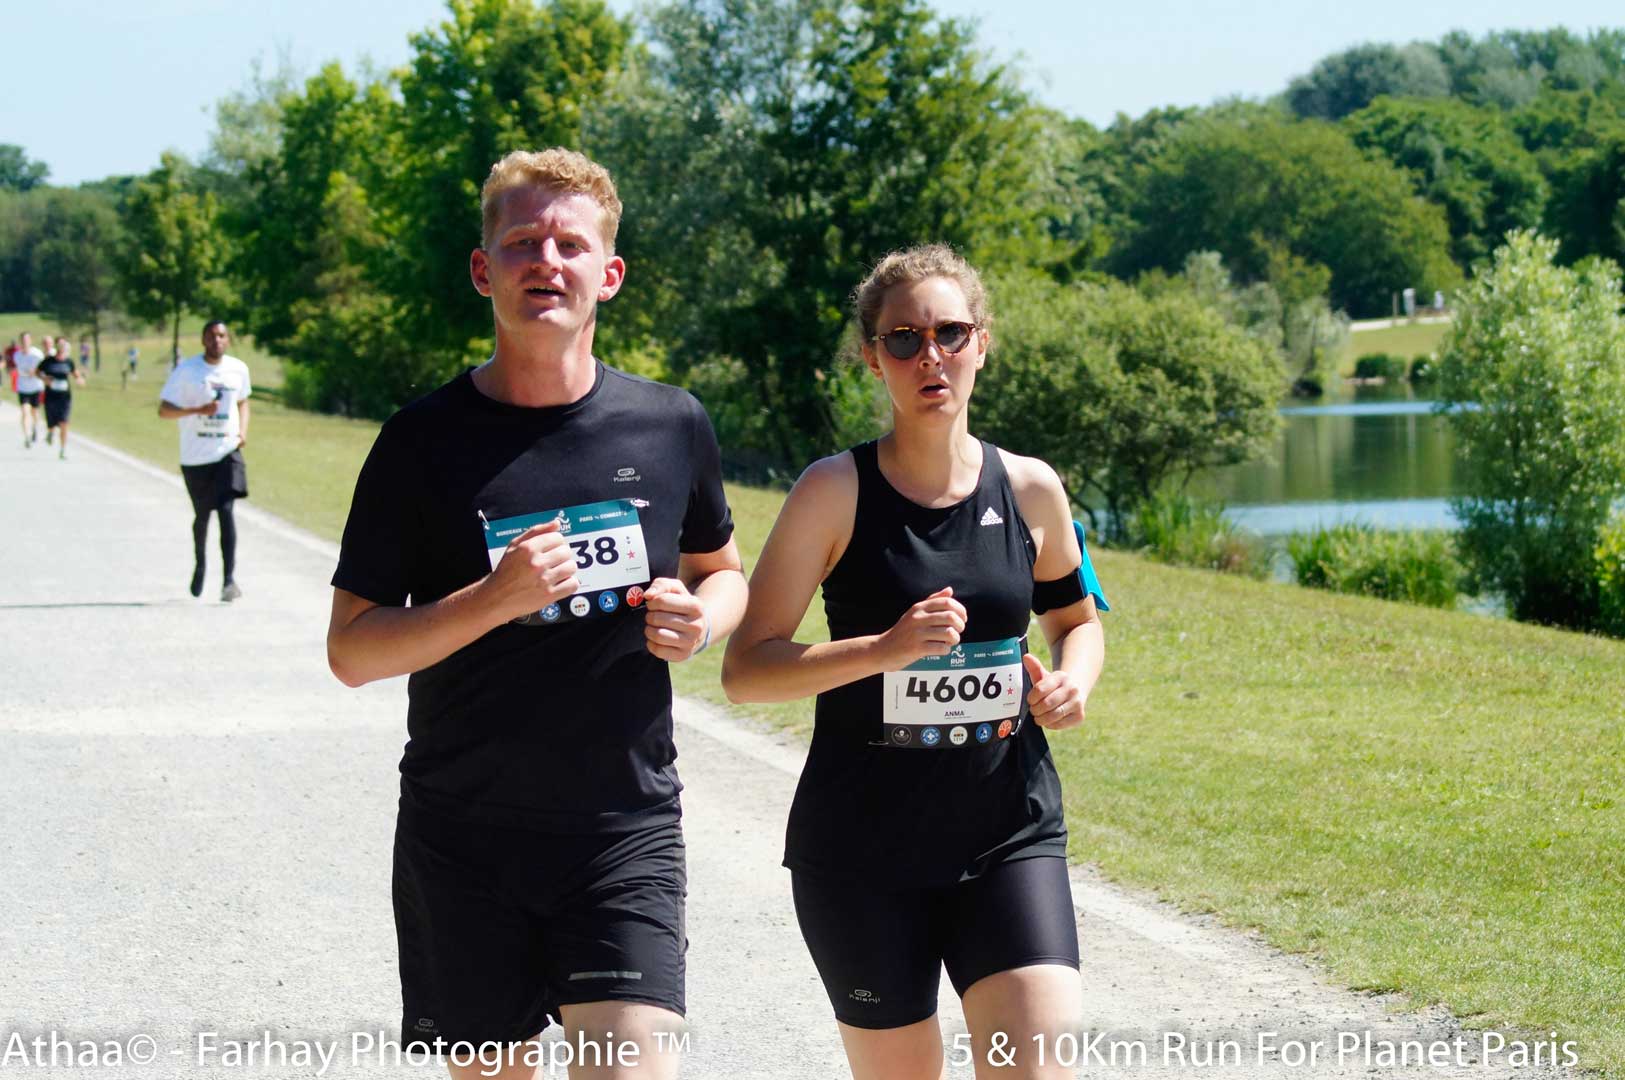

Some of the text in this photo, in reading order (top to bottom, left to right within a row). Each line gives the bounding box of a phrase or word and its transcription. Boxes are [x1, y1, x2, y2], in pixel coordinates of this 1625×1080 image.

[980, 517, 1004, 526] adidas
[569, 536, 619, 569] 38
[906, 672, 1002, 703] 4606
